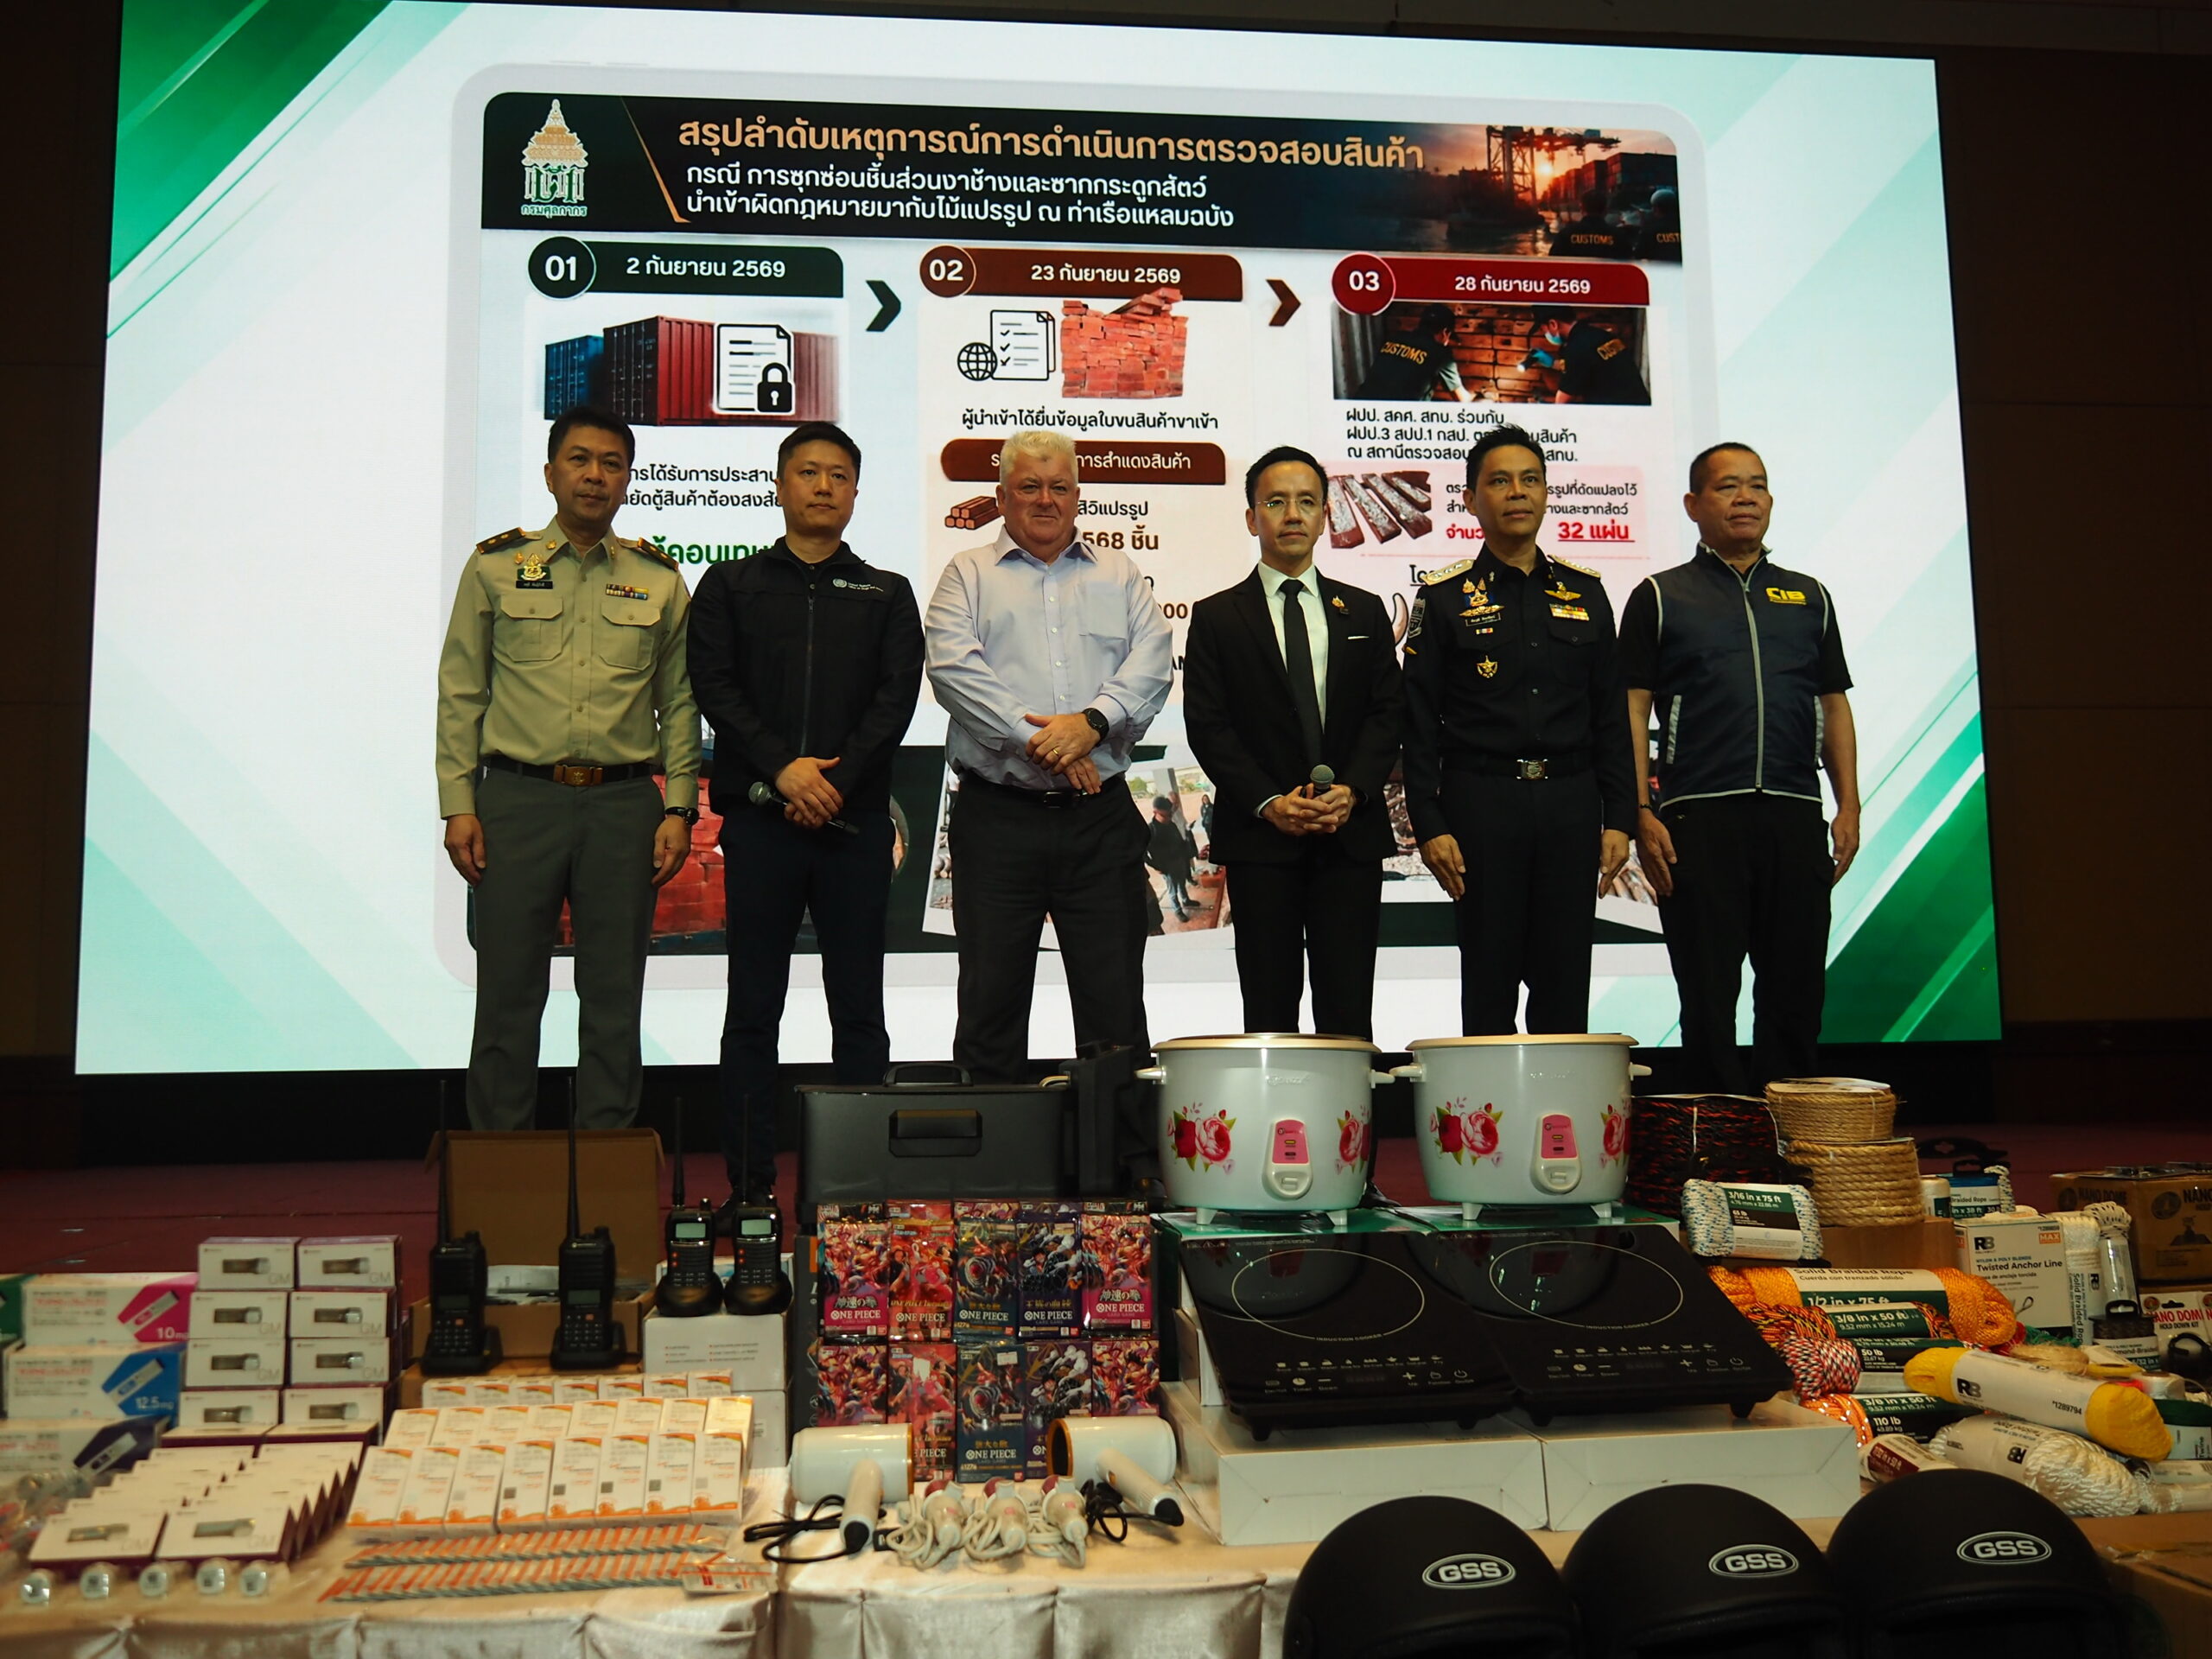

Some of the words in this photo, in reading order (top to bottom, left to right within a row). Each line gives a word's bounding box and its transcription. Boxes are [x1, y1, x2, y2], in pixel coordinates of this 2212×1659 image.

[679, 116, 1424, 168] สรุปลำดับเหตุการณ์การดำเนินการตรวจสอบสินค้า
[687, 162, 741, 186] กรณี
[747, 162, 1207, 202] การซุกซ่อนชิ้นส่วนงาช้างและซากกระดูกสัตว์
[687, 190, 1032, 227] นำเข้าผิดกฎหมายมากับไม้แปรรูป
[1038, 203, 1061, 223] ณ
[1068, 200, 1234, 227] ท่าเรือแหลมฉบัง
[1570, 234, 1614, 246] CUSTOMS
[1656, 232, 1681, 244] CUST
[544, 256, 577, 282] 01
[626, 258, 639, 276] 2
[645, 256, 728, 278] กันยายน
[733, 260, 785, 279] 2569
[929, 259, 963, 282] 02
[1031, 264, 1054, 282] 23
[1059, 262, 1130, 283] กันยายน
[1134, 267, 1181, 285] 2569
[1349, 270, 1380, 292] 03
[1455, 276, 1477, 292] 28
[1480, 274, 1544, 294] กันยายน
[1548, 278, 1591, 295] 2569
[962, 406, 1218, 431] ผู้นำเข้าได้ยื่นข้อมูลใบขนสินค้าขาเข้า
[1457, 408, 1505, 425] ร่วมกับ
[1083, 531, 1125, 550] 568
[1131, 524, 1160, 550] ชิ้น
[1558, 521, 1584, 539] 32
[1589, 519, 1630, 540] แผ่น
[1765, 587, 1806, 601] CIB
[1746, 1192, 1754, 1201] in
[1976, 1262, 2009, 1272] Twisted
[2012, 1261, 2041, 1269] Anchor
[2044, 1259, 2063, 1268] Line
[830, 1310, 852, 1320] ONE
[854, 1309, 880, 1319] PIECE
[959, 1309, 982, 1320] ONE
[982, 1310, 1009, 1321] PIECE
[1024, 1310, 1045, 1320] ONE
[1046, 1310, 1073, 1320] PIECE
[1096, 1303, 1117, 1313] ONE
[1119, 1303, 1145, 1313] PIECE
[2075, 1295, 2084, 1326] Braided
[2148, 1311, 2175, 1323] ANO
[2177, 1309, 2203, 1323] DOM
[896, 1313, 917, 1323] ONE
[919, 1313, 945, 1322] PIECE
[1834, 1313, 1855, 1324] 3/8
[1858, 1313, 1868, 1322] in
[1880, 1312, 1894, 1321] 50
[1874, 1348, 1884, 1357] lb
[1956, 1377, 1981, 1398] RB
[1865, 1396, 1885, 1406] 3/8
[1887, 1396, 1897, 1406] in
[1908, 1396, 1924, 1405] 50
[1872, 1417, 1890, 1426] 110
[1891, 1416, 1901, 1426] lb
[919, 1448, 946, 1458] PIECE
[965, 1449, 988, 1460] ONE
[990, 1449, 1016, 1459] PIECE
[1974, 1539, 2038, 1560] GSS
[1438, 1560, 1502, 1580] GSS
[1725, 1552, 1787, 1573] GSS
